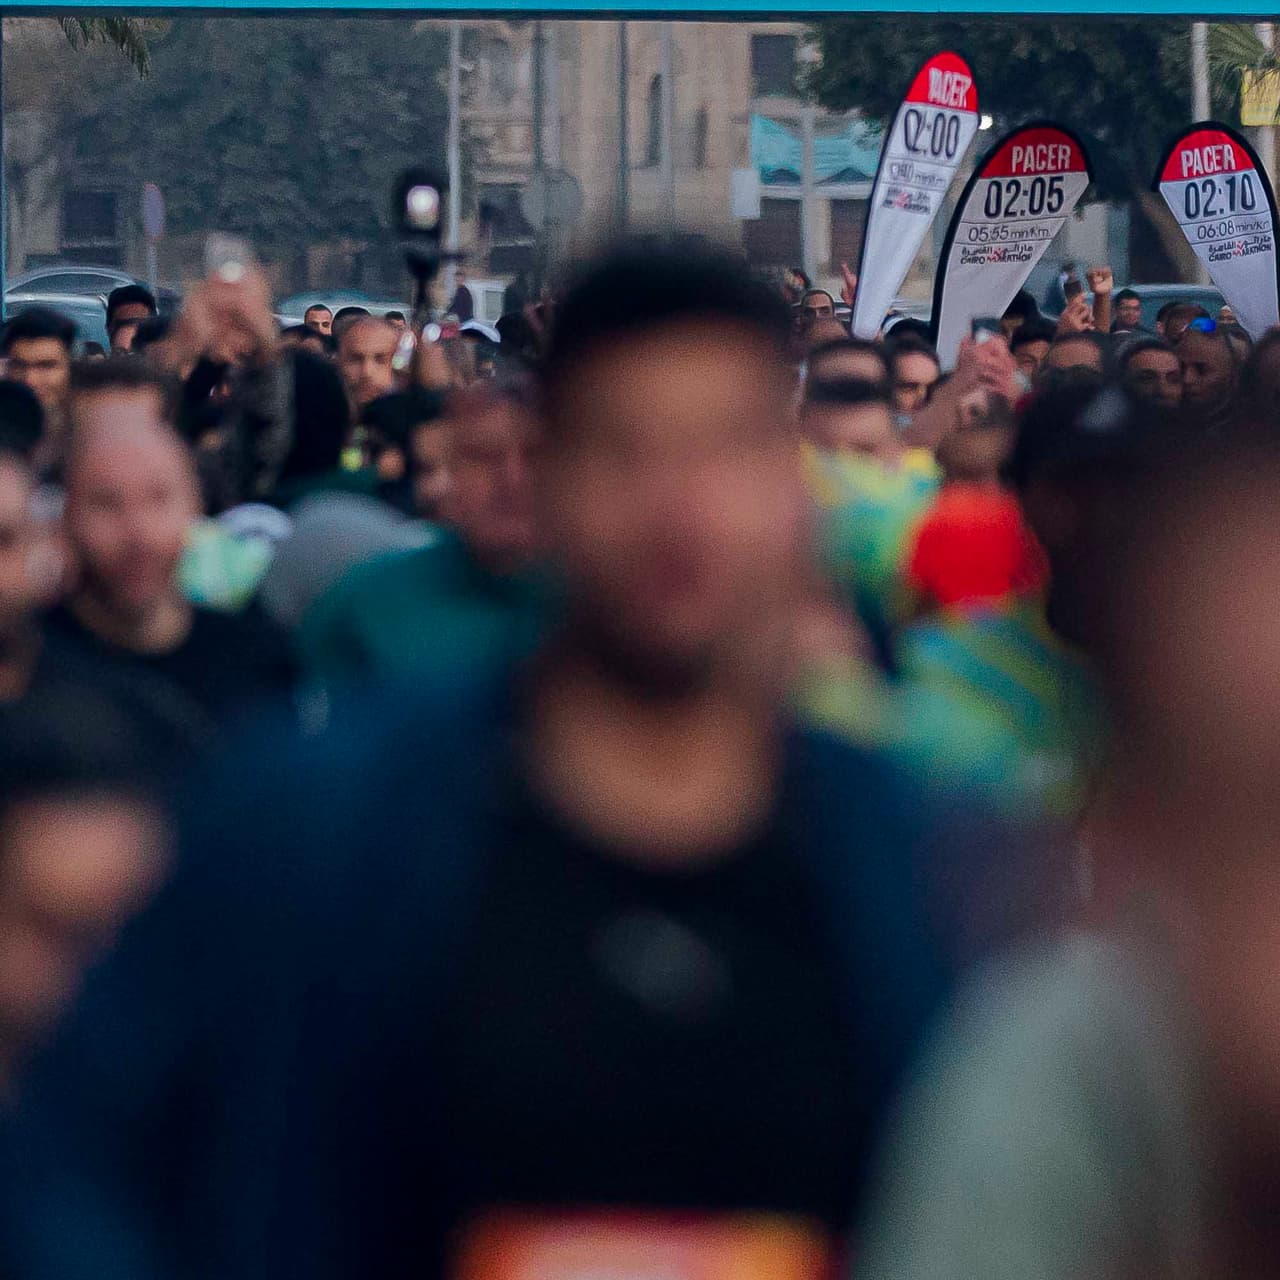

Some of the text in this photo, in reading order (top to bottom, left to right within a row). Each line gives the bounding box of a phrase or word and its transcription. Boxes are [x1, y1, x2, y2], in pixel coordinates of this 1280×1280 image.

[1011, 143, 1072, 174] PACER
[1180, 144, 1236, 178] PACER
[983, 175, 1065, 219] 02:05
[1184, 173, 1256, 220] 02:10
[1197, 220, 1235, 240] 06:08
